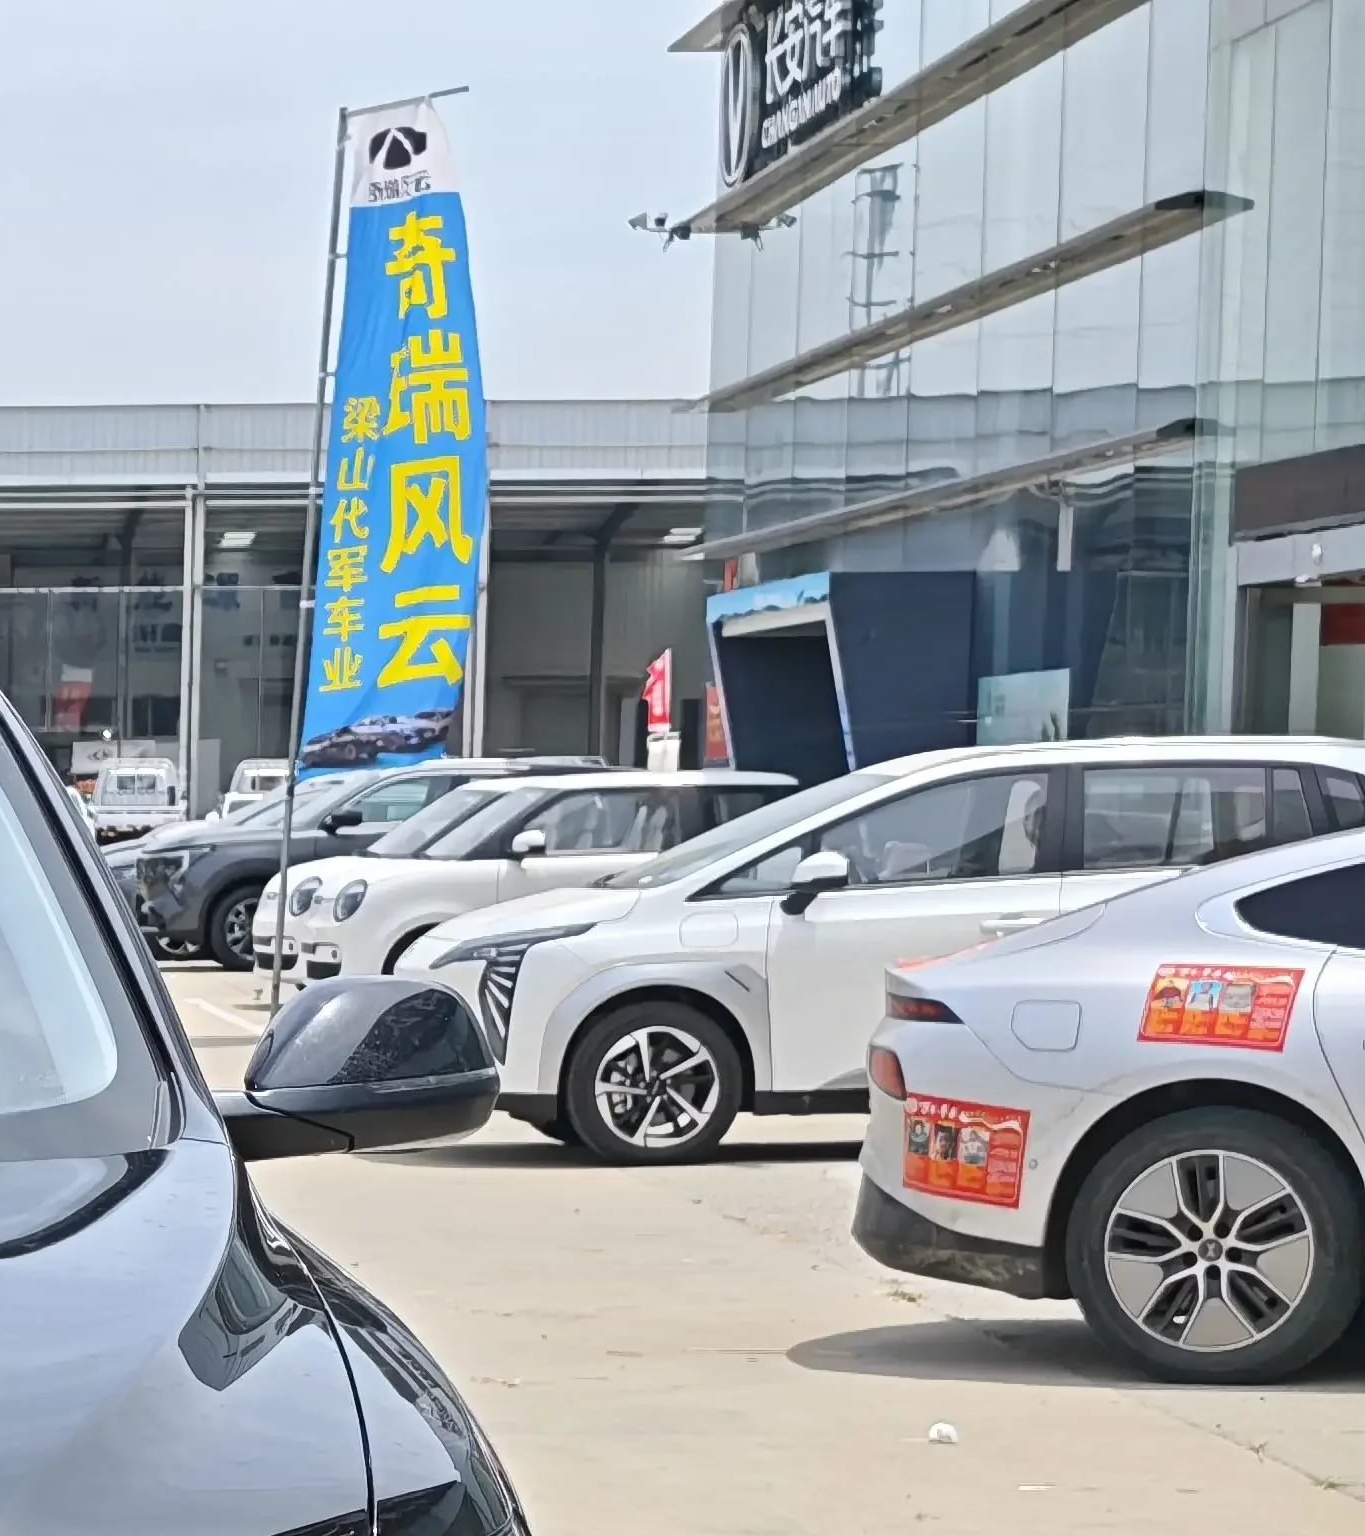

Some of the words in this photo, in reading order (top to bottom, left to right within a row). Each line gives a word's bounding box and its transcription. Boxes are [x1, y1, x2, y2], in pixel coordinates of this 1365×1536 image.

[319, 396, 382, 693] 梁山代军车业
[378, 210, 473, 688] 奇瑞风云
